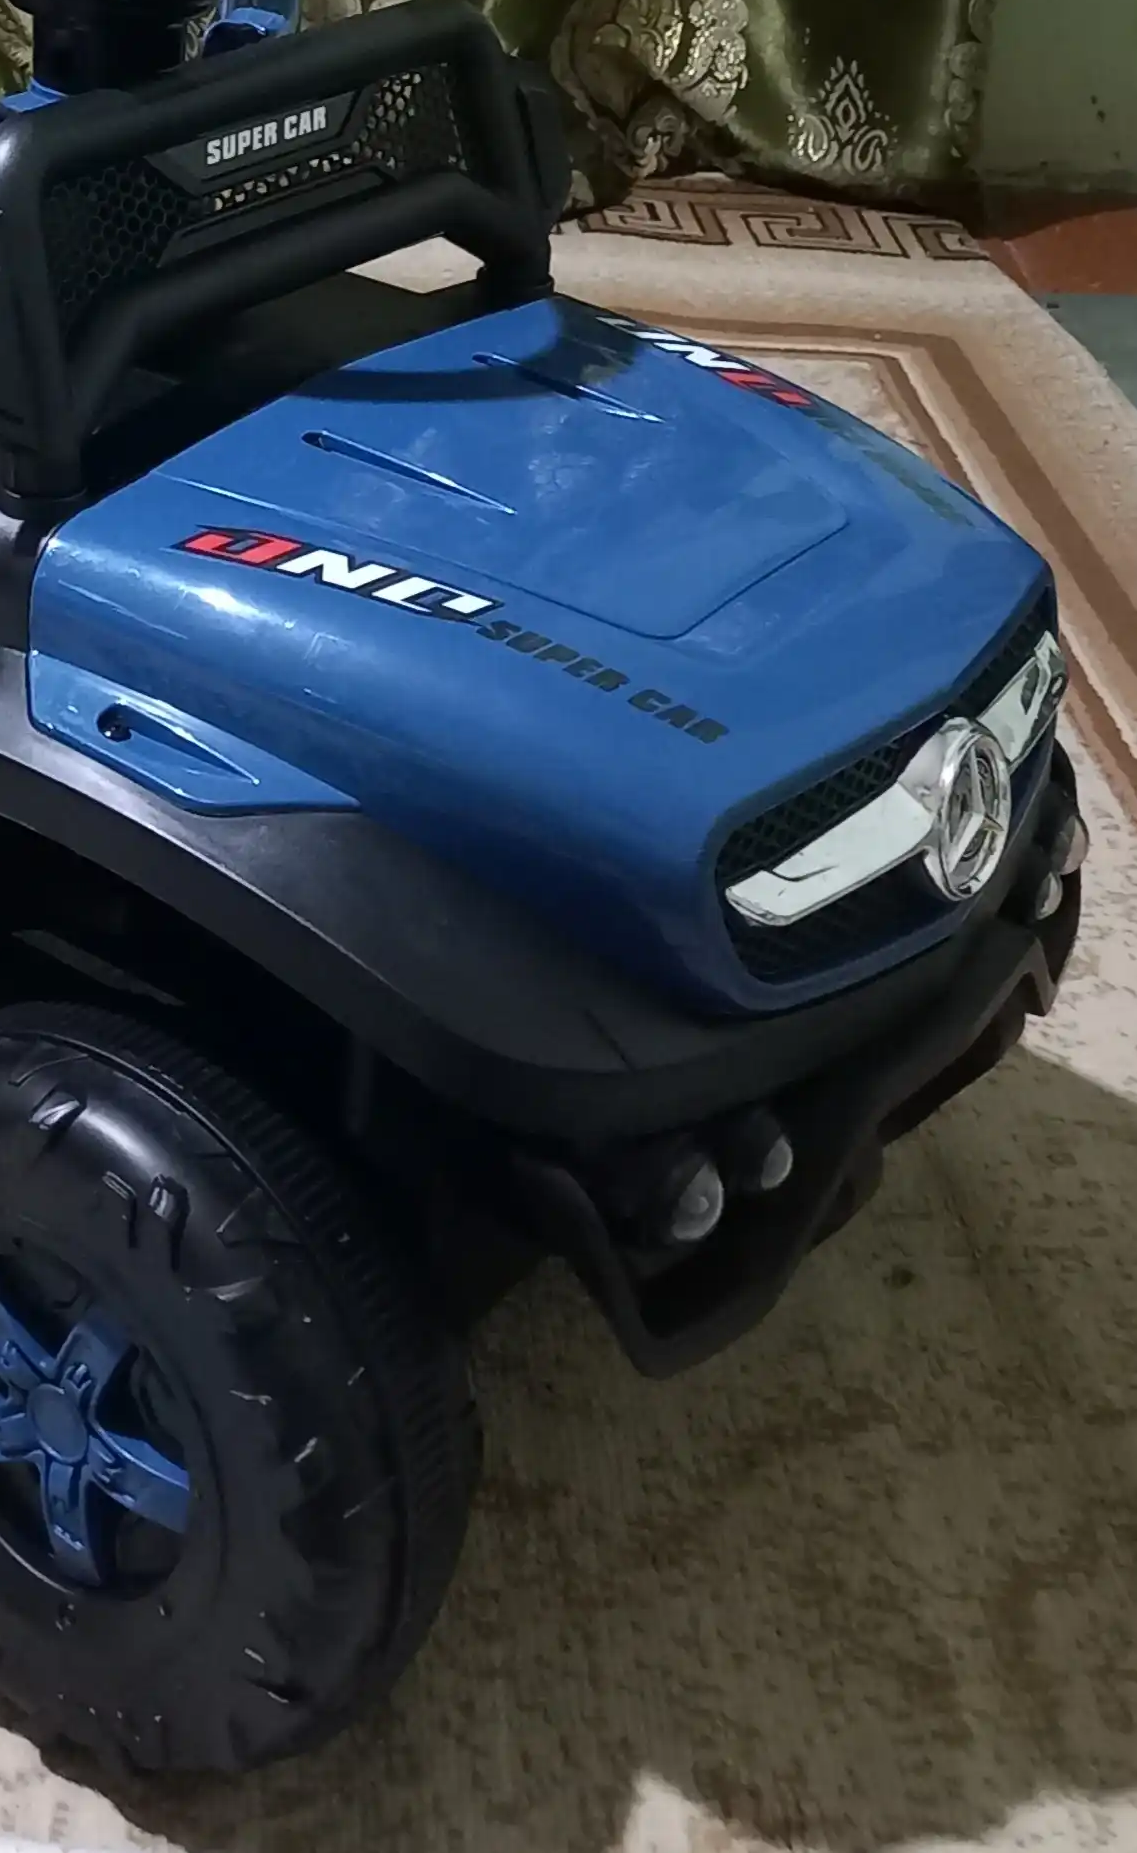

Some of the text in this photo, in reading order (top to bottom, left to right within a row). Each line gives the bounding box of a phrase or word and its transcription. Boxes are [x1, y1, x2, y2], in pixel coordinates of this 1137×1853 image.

[206, 105, 327, 166] SUPER CAR
[476, 620, 730, 745] SUPER CAR
